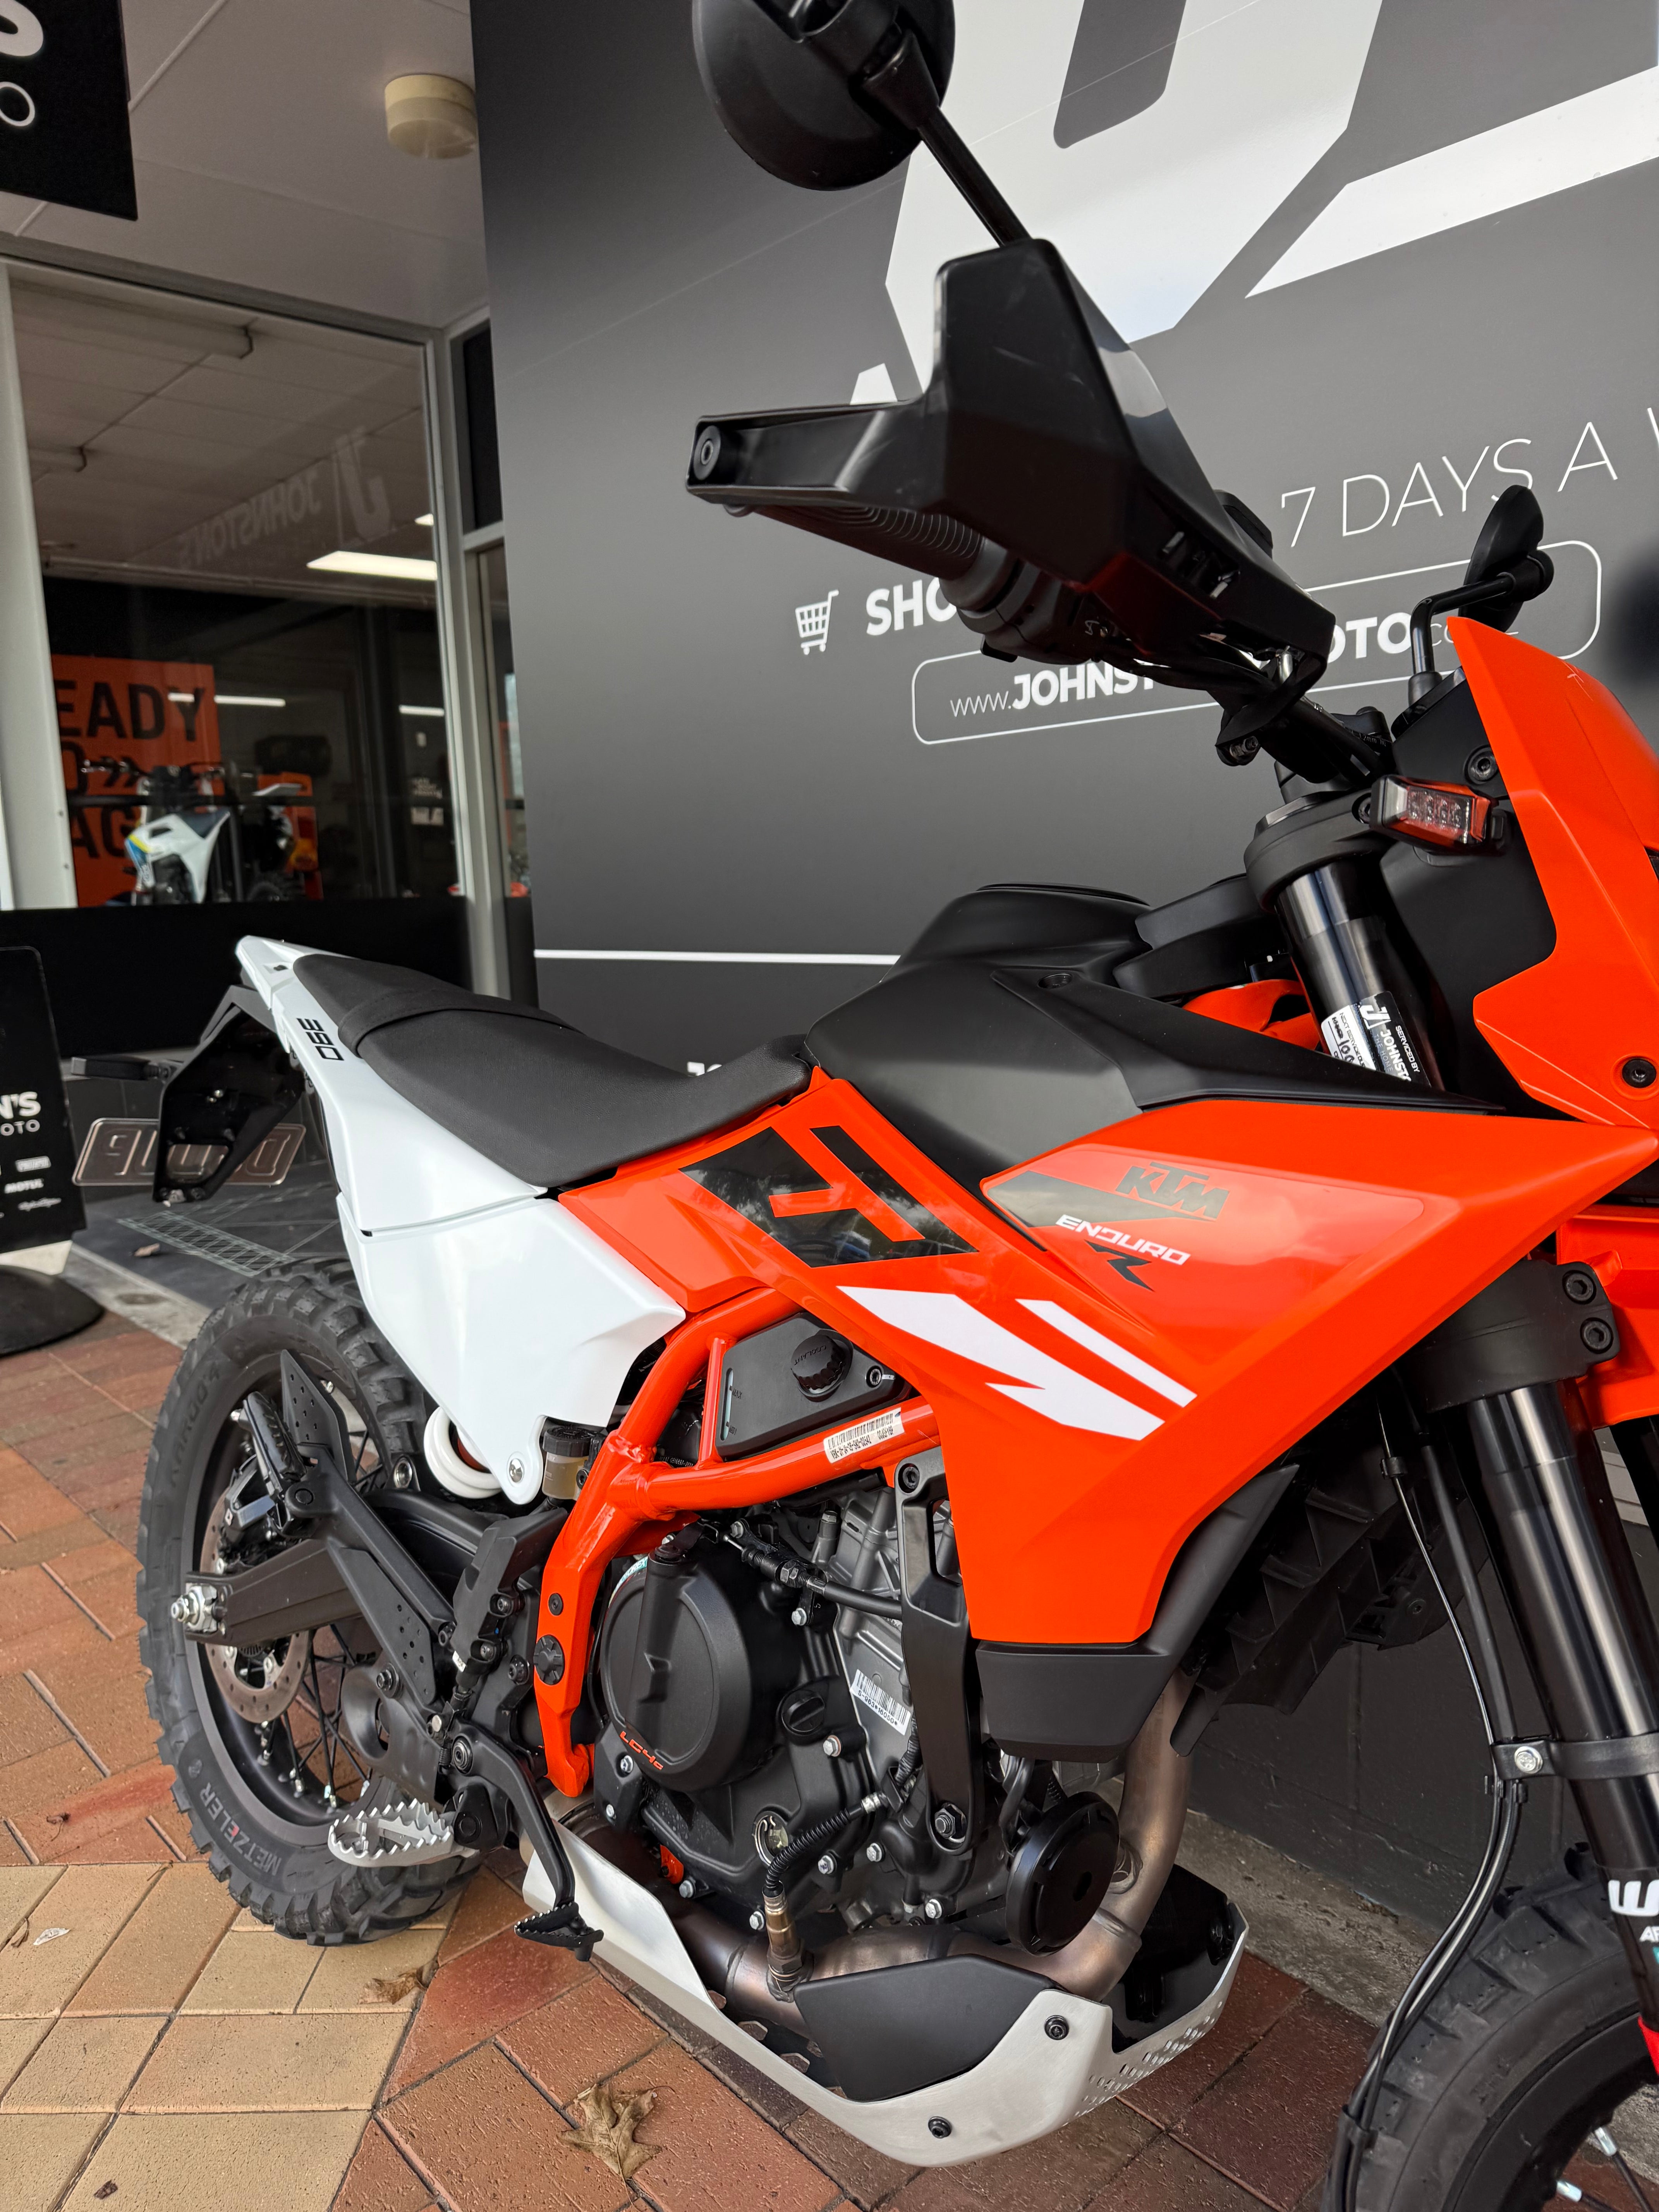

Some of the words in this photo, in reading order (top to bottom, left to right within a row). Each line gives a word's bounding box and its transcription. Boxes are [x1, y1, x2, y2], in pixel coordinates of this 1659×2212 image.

[1281, 486, 1316, 548] 7
[1342, 438, 1532, 537] DAYS
[1558, 422, 1618, 492] A
[1115, 1161, 1230, 1221] KTM
[1055, 1214, 1191, 1266] ENDURO
[199, 1781, 282, 1877] METZELER
